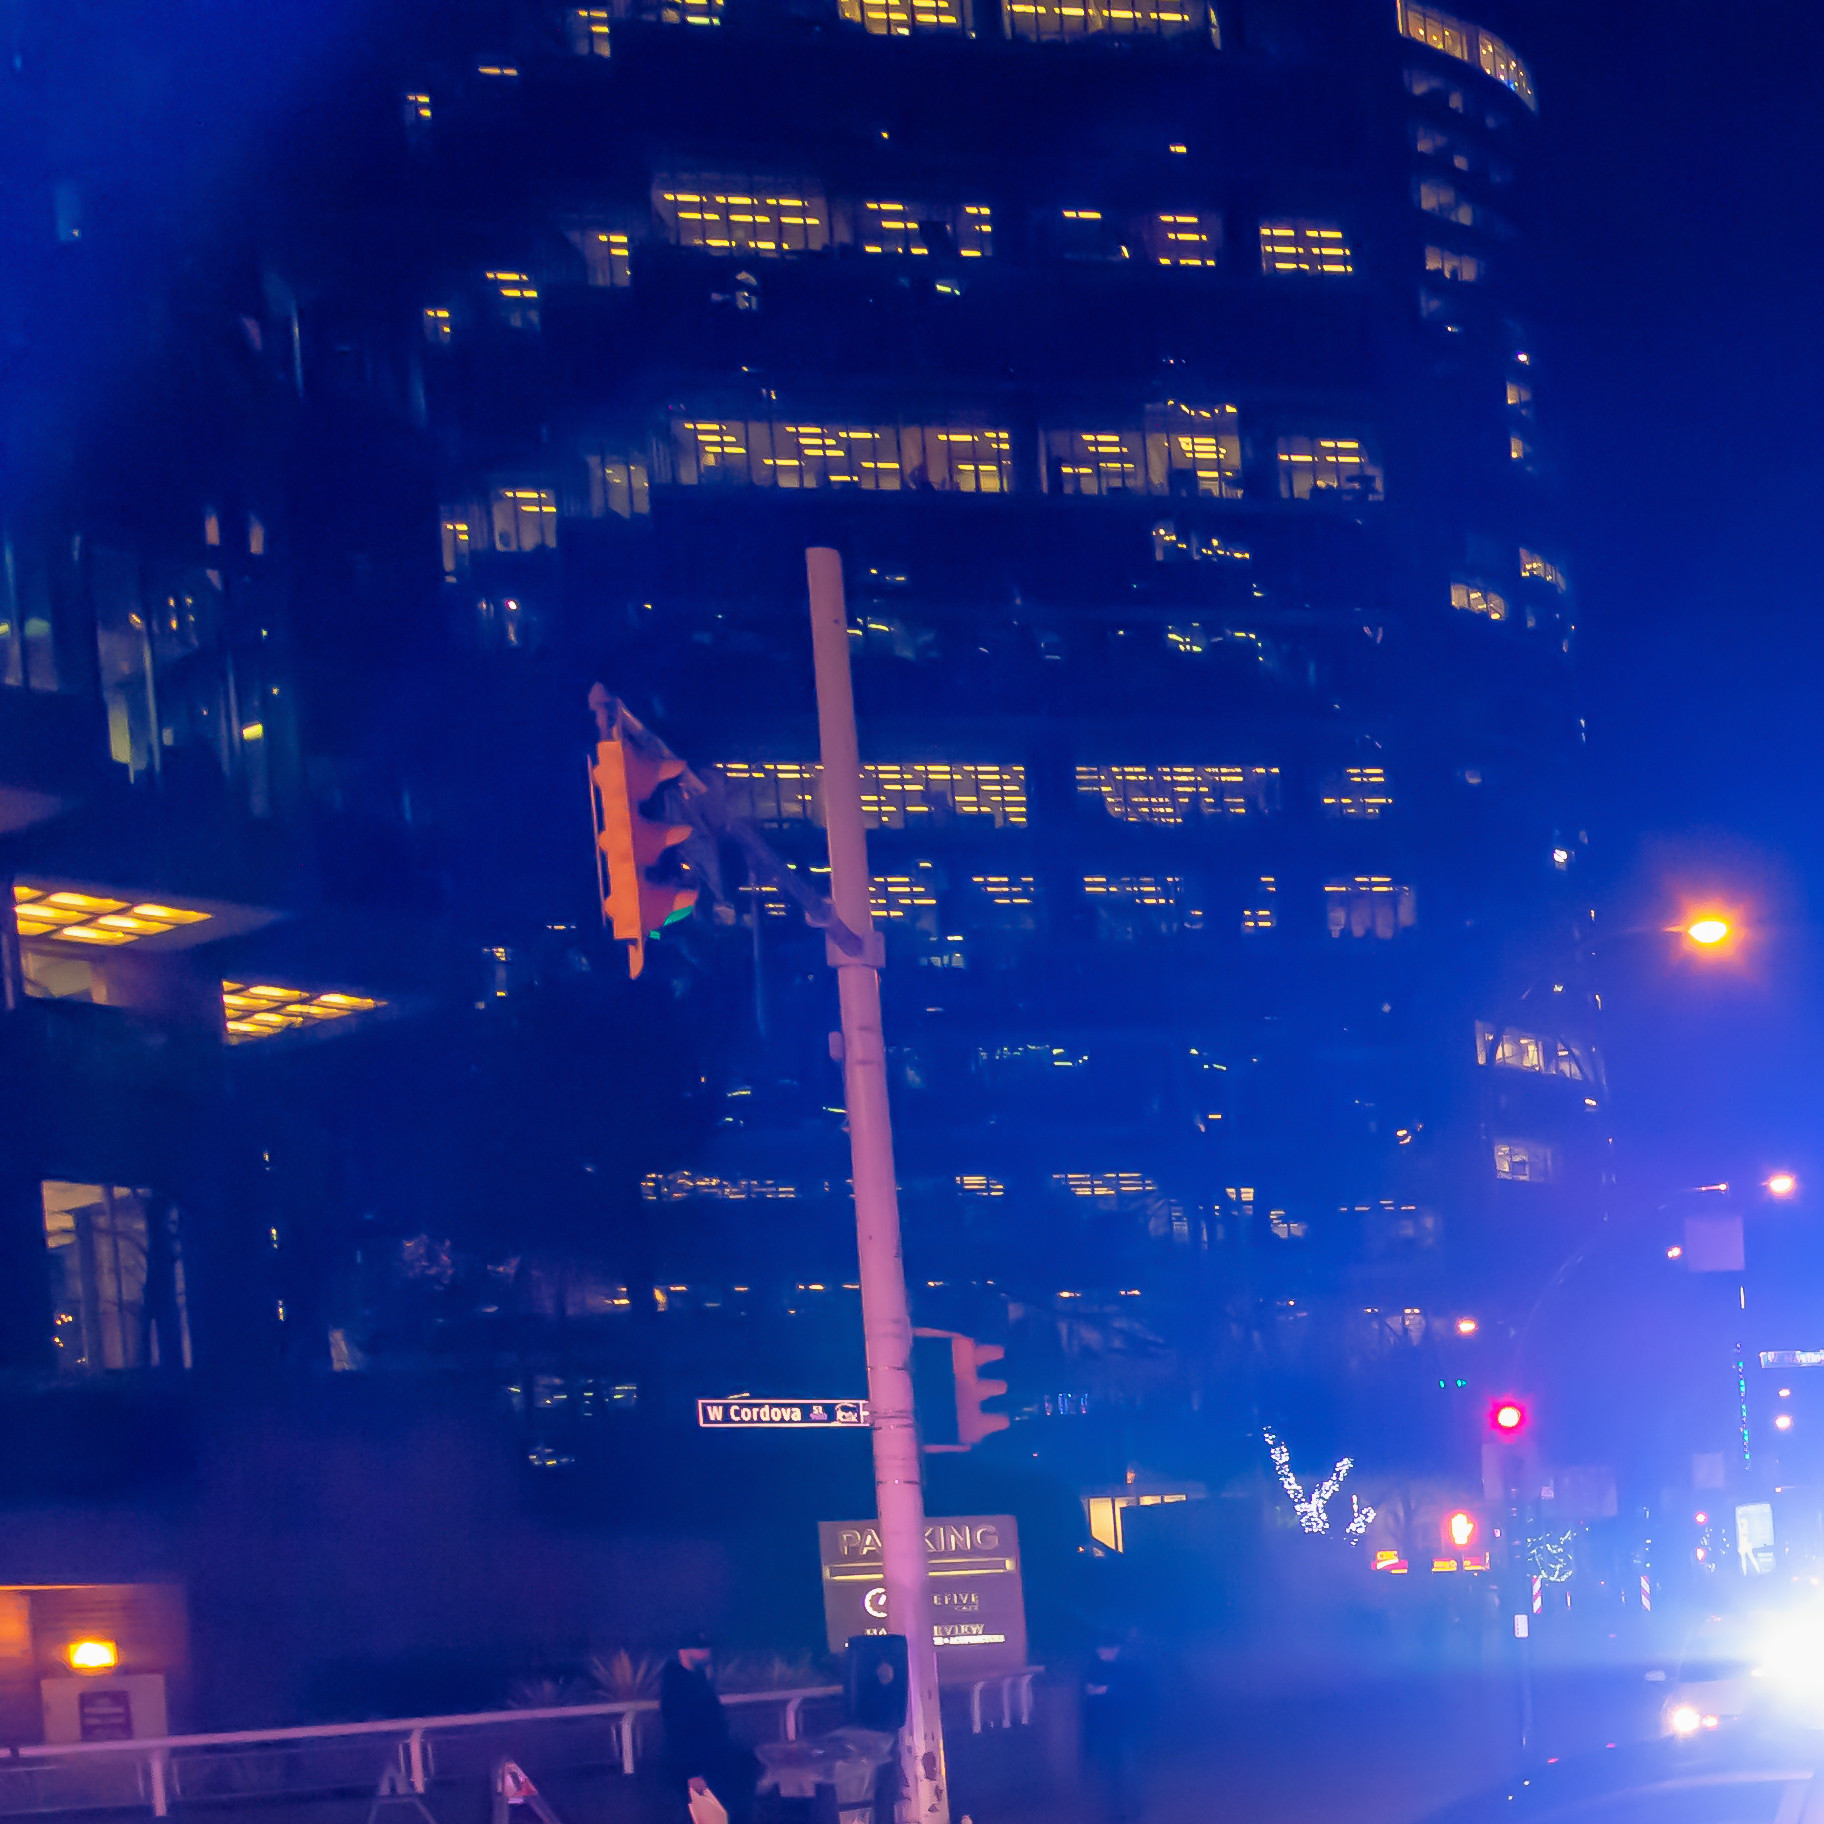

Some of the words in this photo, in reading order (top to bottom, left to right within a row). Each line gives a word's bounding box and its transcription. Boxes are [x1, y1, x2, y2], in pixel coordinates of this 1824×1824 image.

[707, 1405, 722, 1421] W
[730, 1404, 802, 1422] Cordova
[839, 1525, 999, 1557] PAKING
